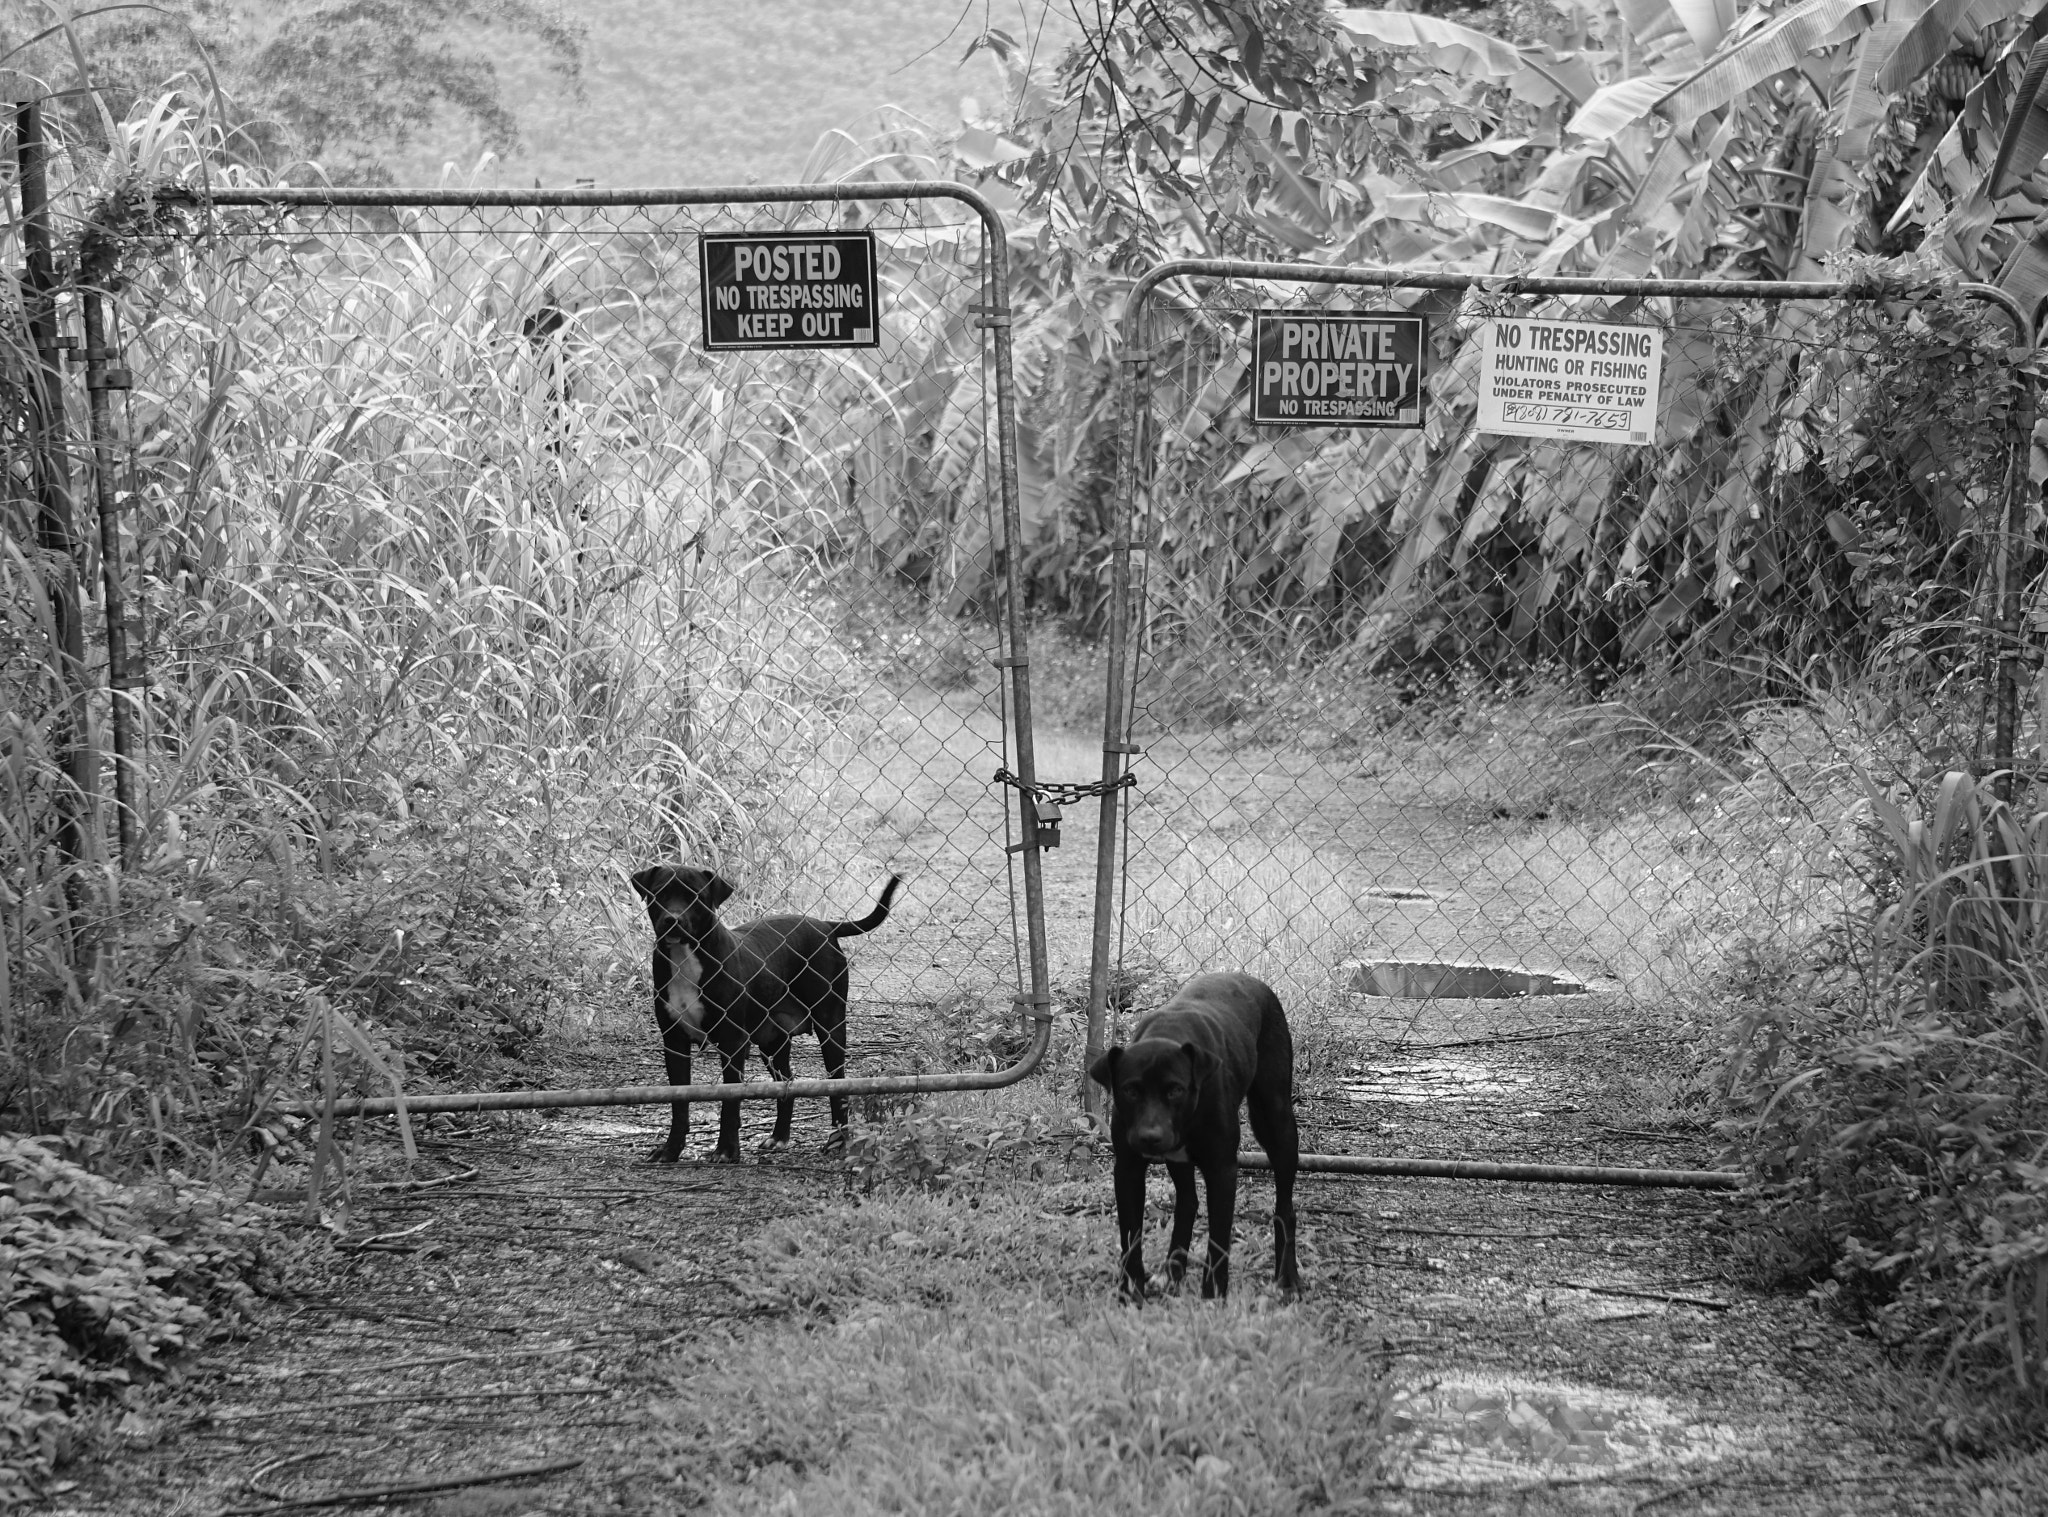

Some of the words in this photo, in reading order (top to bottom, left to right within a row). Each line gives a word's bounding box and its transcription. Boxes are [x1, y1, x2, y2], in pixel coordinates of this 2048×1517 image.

[734, 245, 841, 282] POSTED
[716, 286, 740, 310] NO
[746, 284, 862, 310] TRESPASSING
[738, 313, 794, 338] KEEP
[802, 312, 844, 337] OUT
[1282, 323, 1396, 360] PRIVATE
[1496, 324, 1522, 348] NO
[1529, 326, 1652, 358] TRESPASSING
[1263, 361, 1413, 398] PROPERTY
[1495, 354, 1558, 374] HUNTING
[1564, 359, 1584, 376] OR
[1590, 360, 1647, 380] FISHING
[1492, 388, 1533, 400] UNDER
[1538, 392, 1592, 404] PENALTY
[1597, 395, 1614, 406] OF
[1618, 397, 1645, 408] LAW
[1494, 376, 1561, 390] VIOLATORS
[1566, 382, 1647, 396] PROSECUTED
[1279, 400, 1298, 415] NO
[1304, 400, 1396, 417] TRESPASSING
